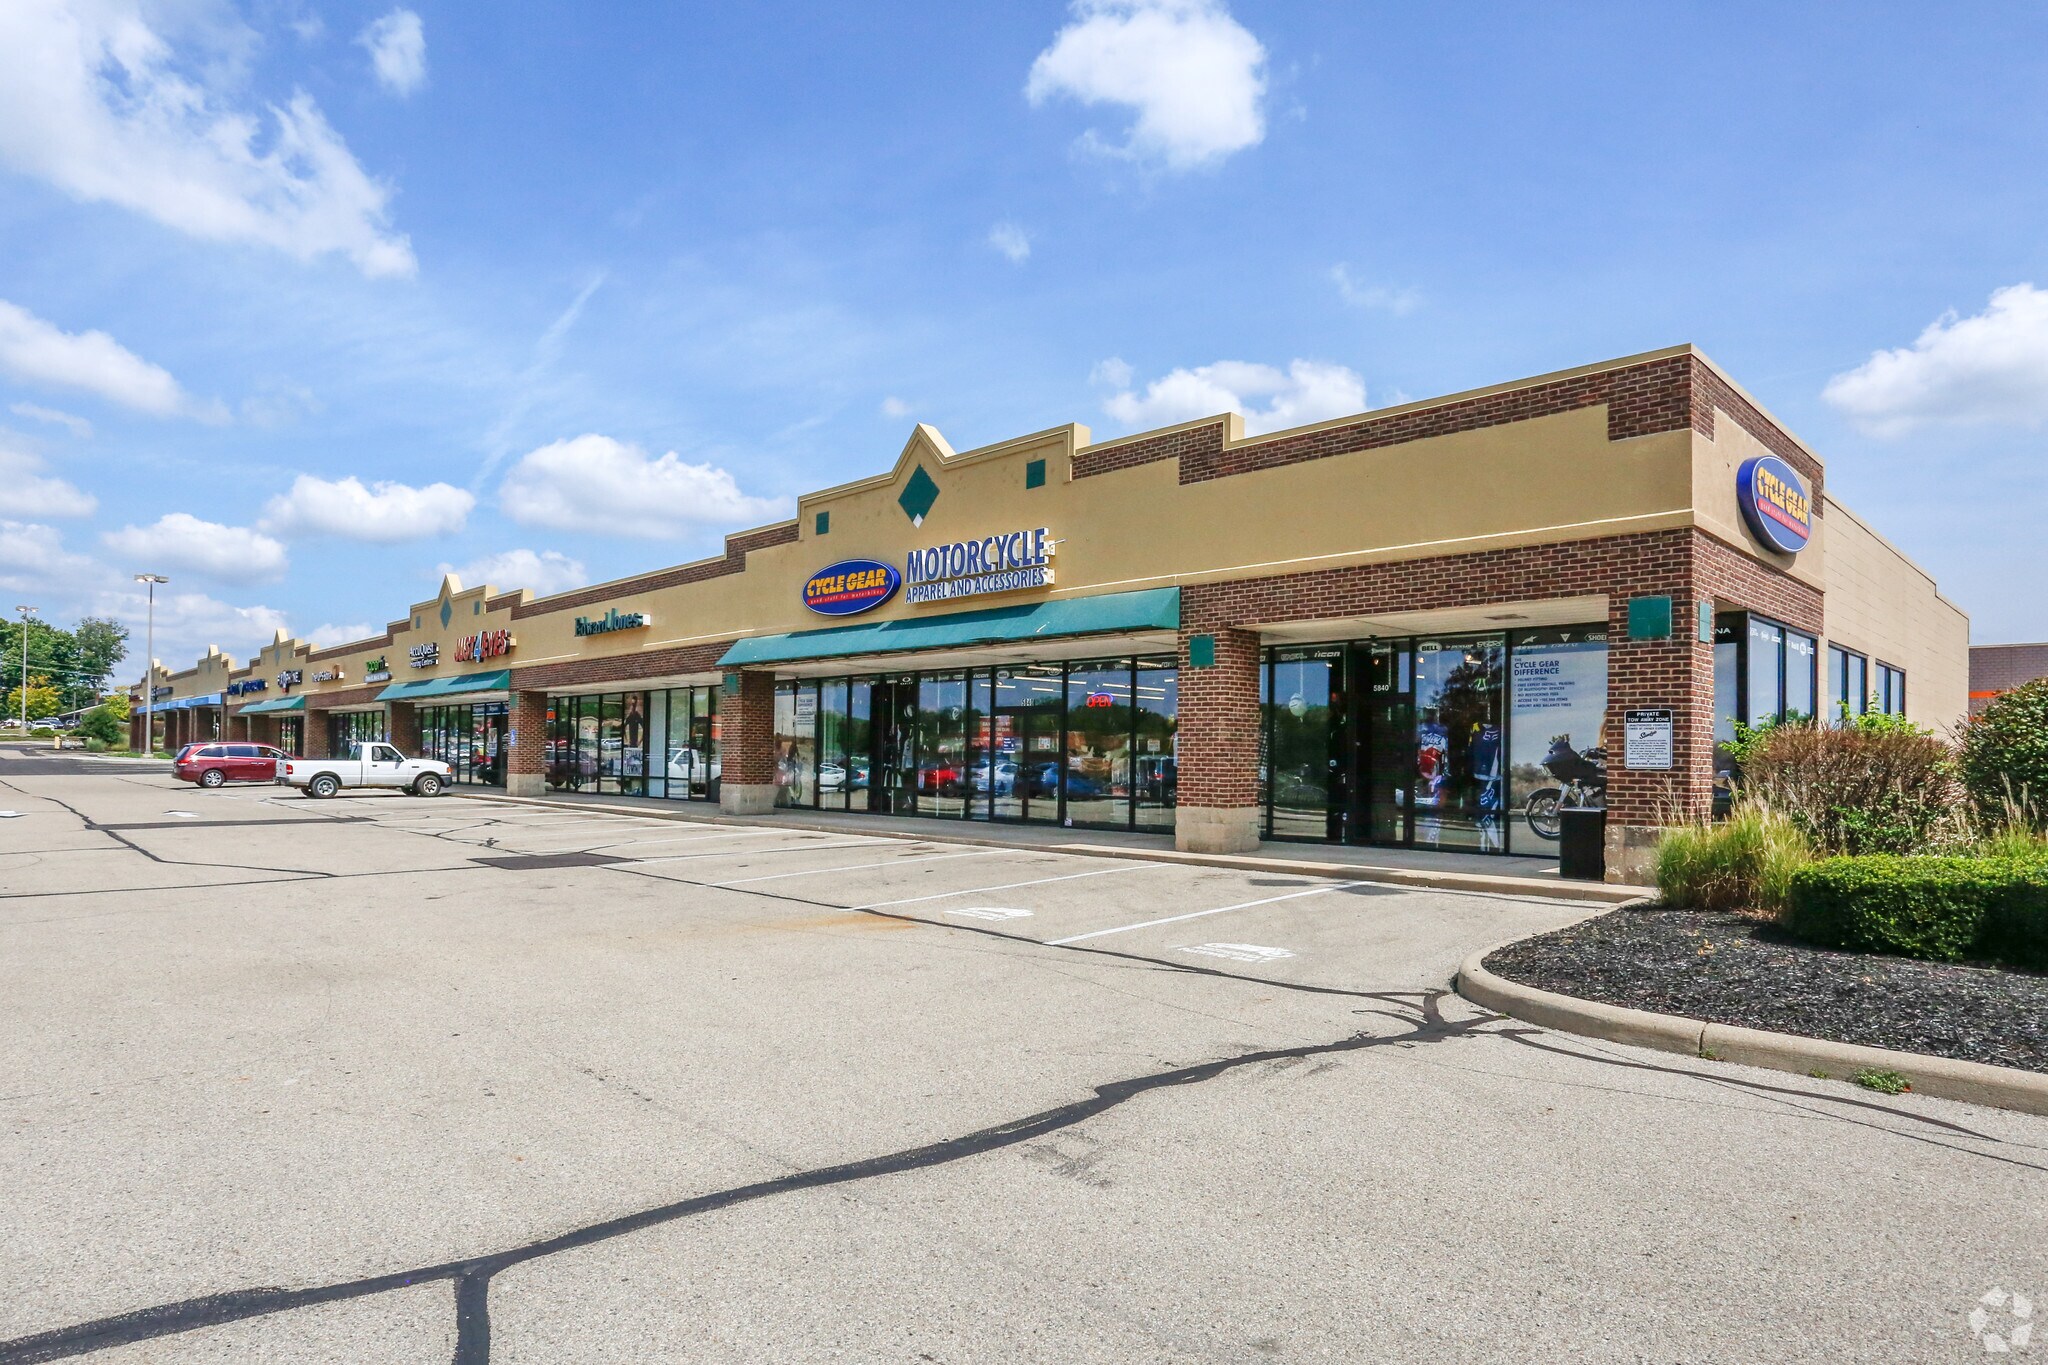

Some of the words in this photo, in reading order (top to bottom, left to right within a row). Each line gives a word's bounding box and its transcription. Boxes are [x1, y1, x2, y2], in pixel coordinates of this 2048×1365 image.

[1757, 466, 1786, 510] CYCLE
[1785, 487, 1809, 527] GEAR
[905, 527, 1047, 584] MOTORCYCLE
[806, 575, 846, 597] CYCLE
[846, 568, 887, 591] GEAR
[905, 582, 947, 604] APPAREL
[950, 578, 972, 597] AND
[974, 567, 1047, 595] ACCESSORIES
[574, 612, 609, 637] Edward
[607, 607, 640, 631] Jones
[1514, 661, 1537, 669] CYCLE
[1538, 660, 1560, 668] GEAR
[1514, 668, 1560, 676] DIFFERENCE
[1087, 695, 1112, 708] OPEN
[1373, 684, 1390, 692] 5840
